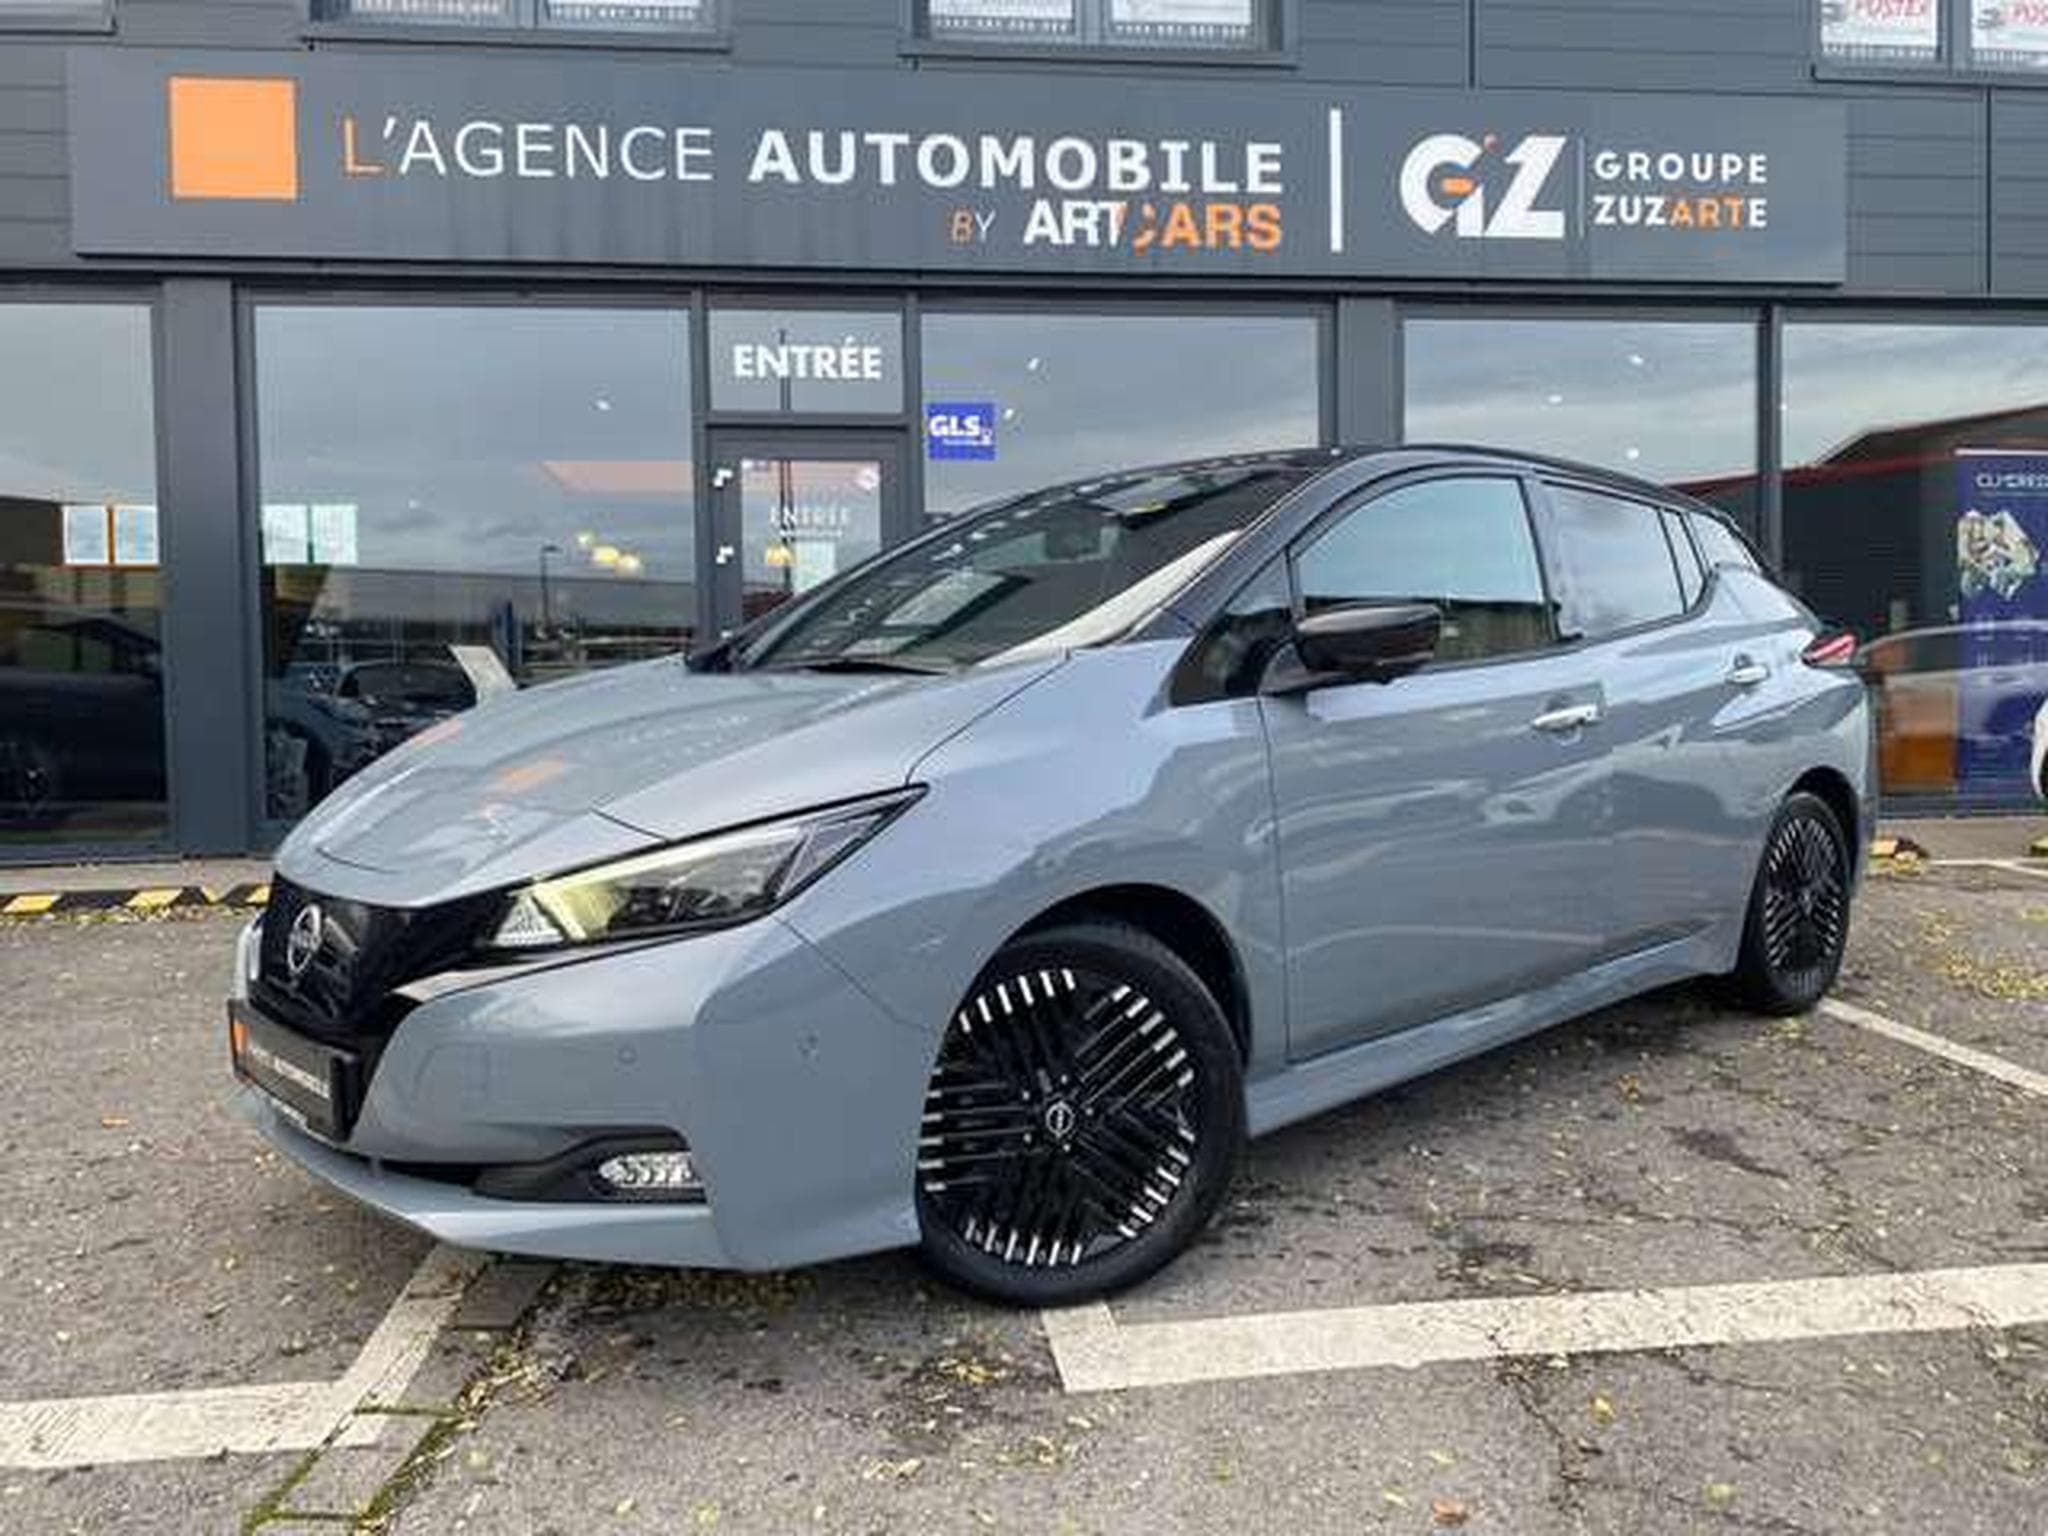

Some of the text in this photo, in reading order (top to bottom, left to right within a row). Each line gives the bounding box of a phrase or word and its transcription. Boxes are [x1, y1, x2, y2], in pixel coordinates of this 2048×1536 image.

[343, 117, 1283, 195] L'AGENCE AUTOMOBILE
[1593, 151, 1768, 185] GROUPE
[951, 208, 996, 244] BY
[1593, 194, 1768, 228] ZUZARTE
[733, 335, 882, 379] ENTRÉE
[929, 414, 980, 437] GLS
